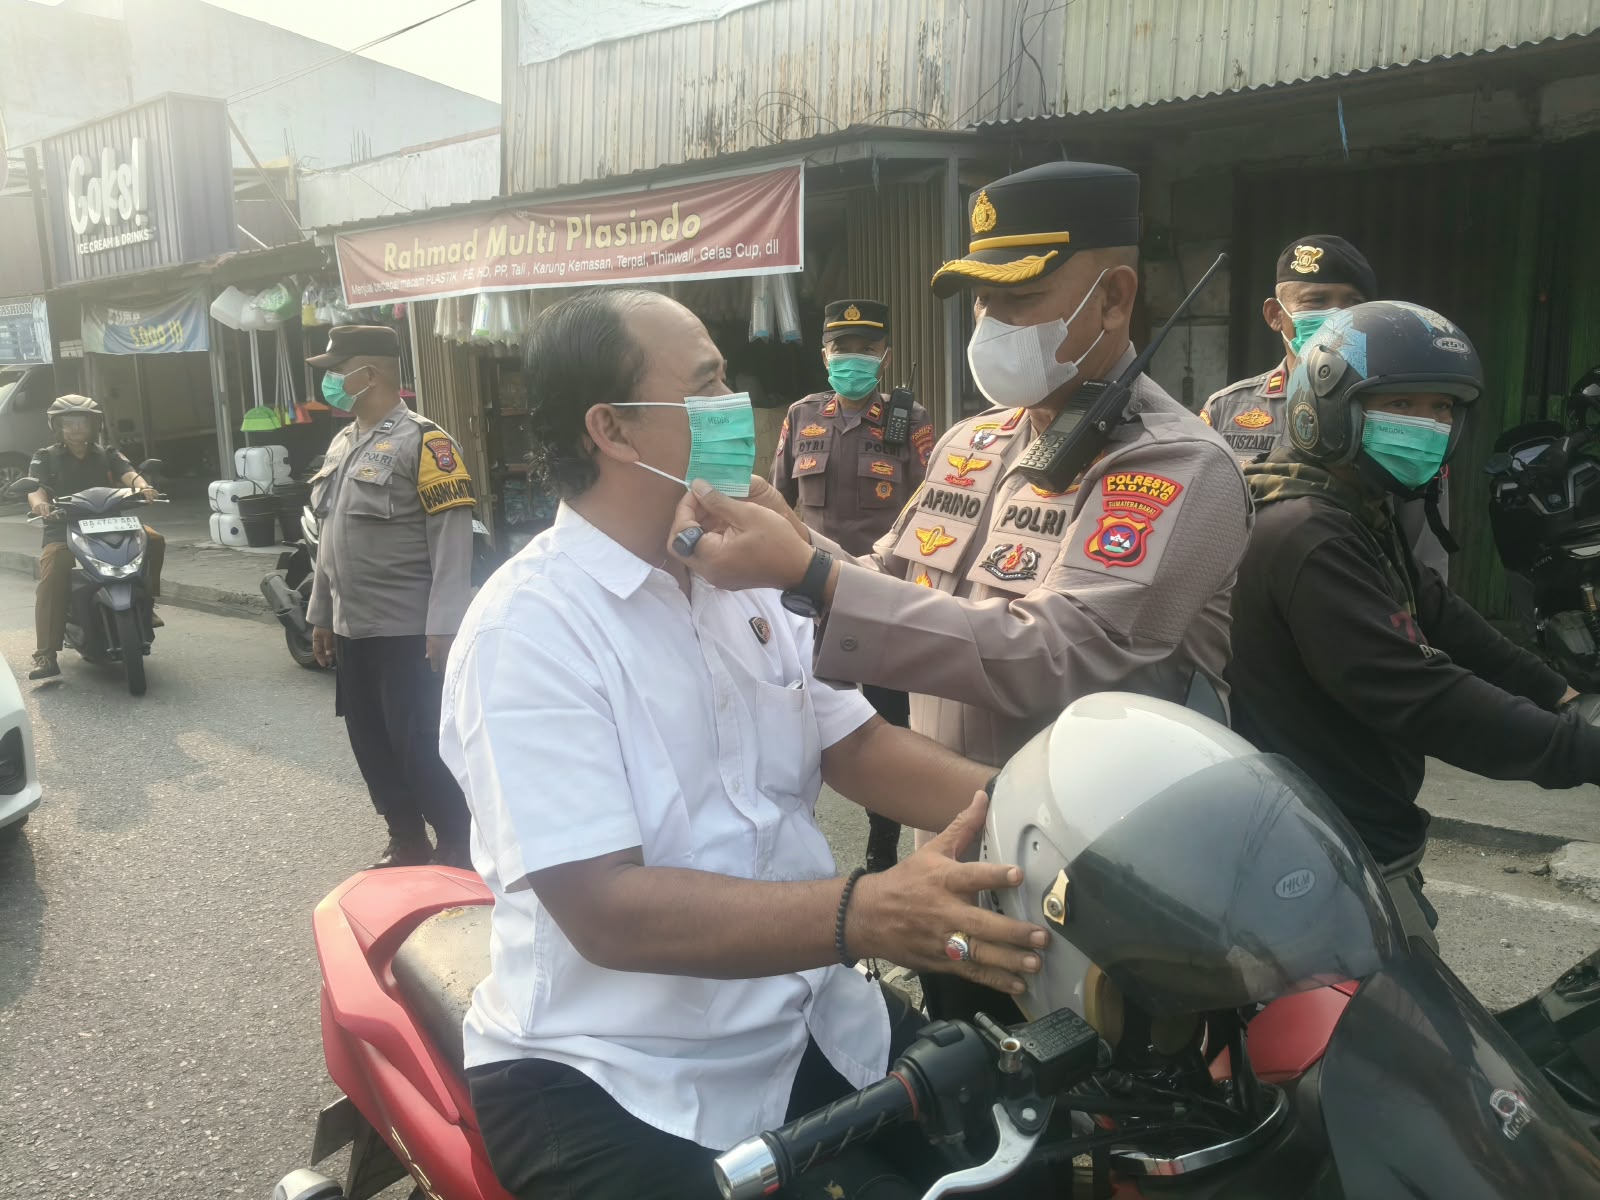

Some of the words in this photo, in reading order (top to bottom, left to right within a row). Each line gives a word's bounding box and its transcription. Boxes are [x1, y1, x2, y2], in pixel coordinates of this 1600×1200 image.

[77, 243, 89, 255] ICE
[89, 236, 114, 253] CREAM
[115, 235, 121, 247] &
[121, 229, 149, 246] DRINKS
[384, 228, 478, 272] Rahmad
[485, 219, 556, 259] Multi
[566, 202, 701, 251] Plasindo
[533, 261, 566, 276] Karung
[568, 257, 614, 272] Kemasan,
[617, 253, 648, 268] Terpal,
[651, 247, 696, 265] Thinwall,
[700, 245, 732, 261] Gelas
[735, 242, 762, 259] Cup,
[765, 238, 779, 255] dll
[362, 451, 393, 465] POLRI
[1106, 474, 1176, 496] POLRESTA
[1107, 484, 1170, 501] PADANG
[920, 487, 981, 518] AFRINO
[1108, 501, 1139, 509] SUMATERA
[1138, 504, 1156, 516] BARAT
[1000, 504, 1067, 537] POLRI
